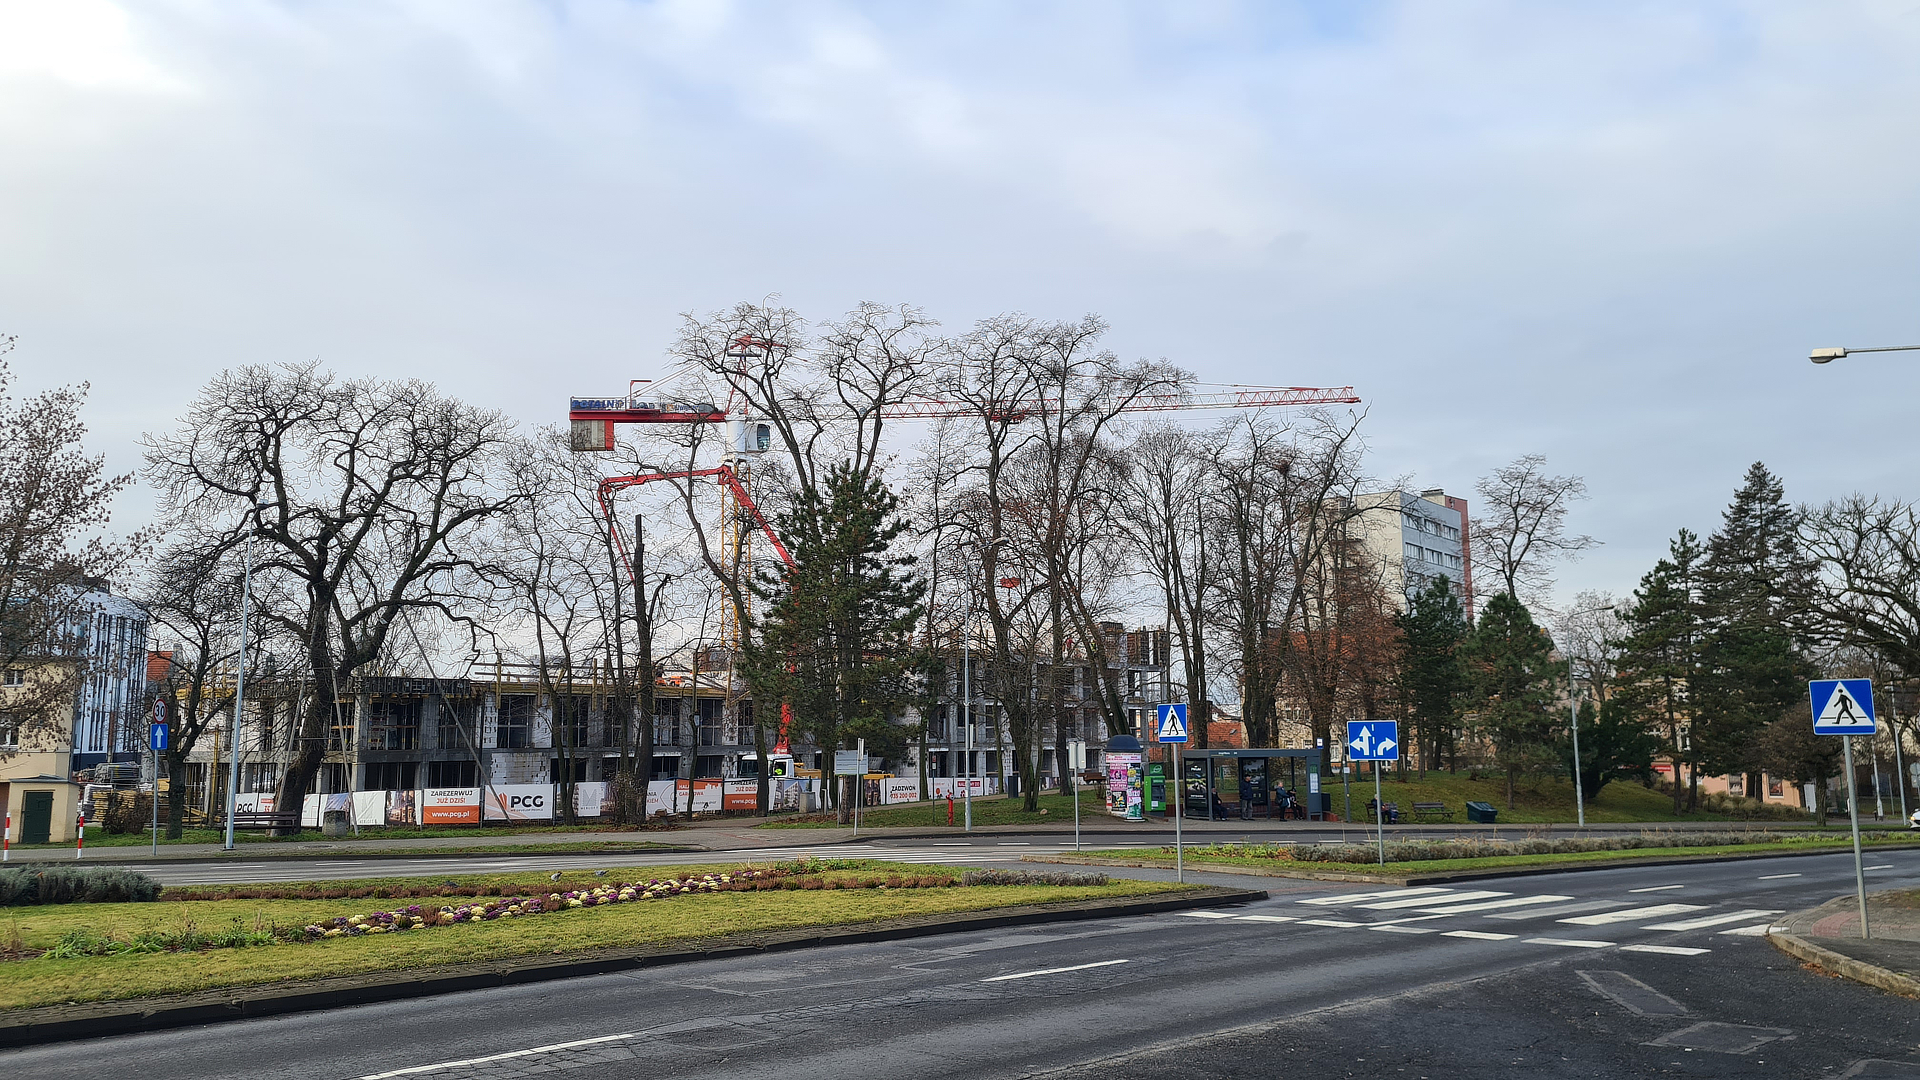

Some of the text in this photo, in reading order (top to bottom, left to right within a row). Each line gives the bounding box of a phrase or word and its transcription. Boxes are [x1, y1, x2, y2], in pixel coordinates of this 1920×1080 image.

[155, 705, 165, 717] 30
[511, 795, 544, 808] PCG
[237, 803, 253, 813] PCG
[431, 810, 470, 818] www.pcg.pl
